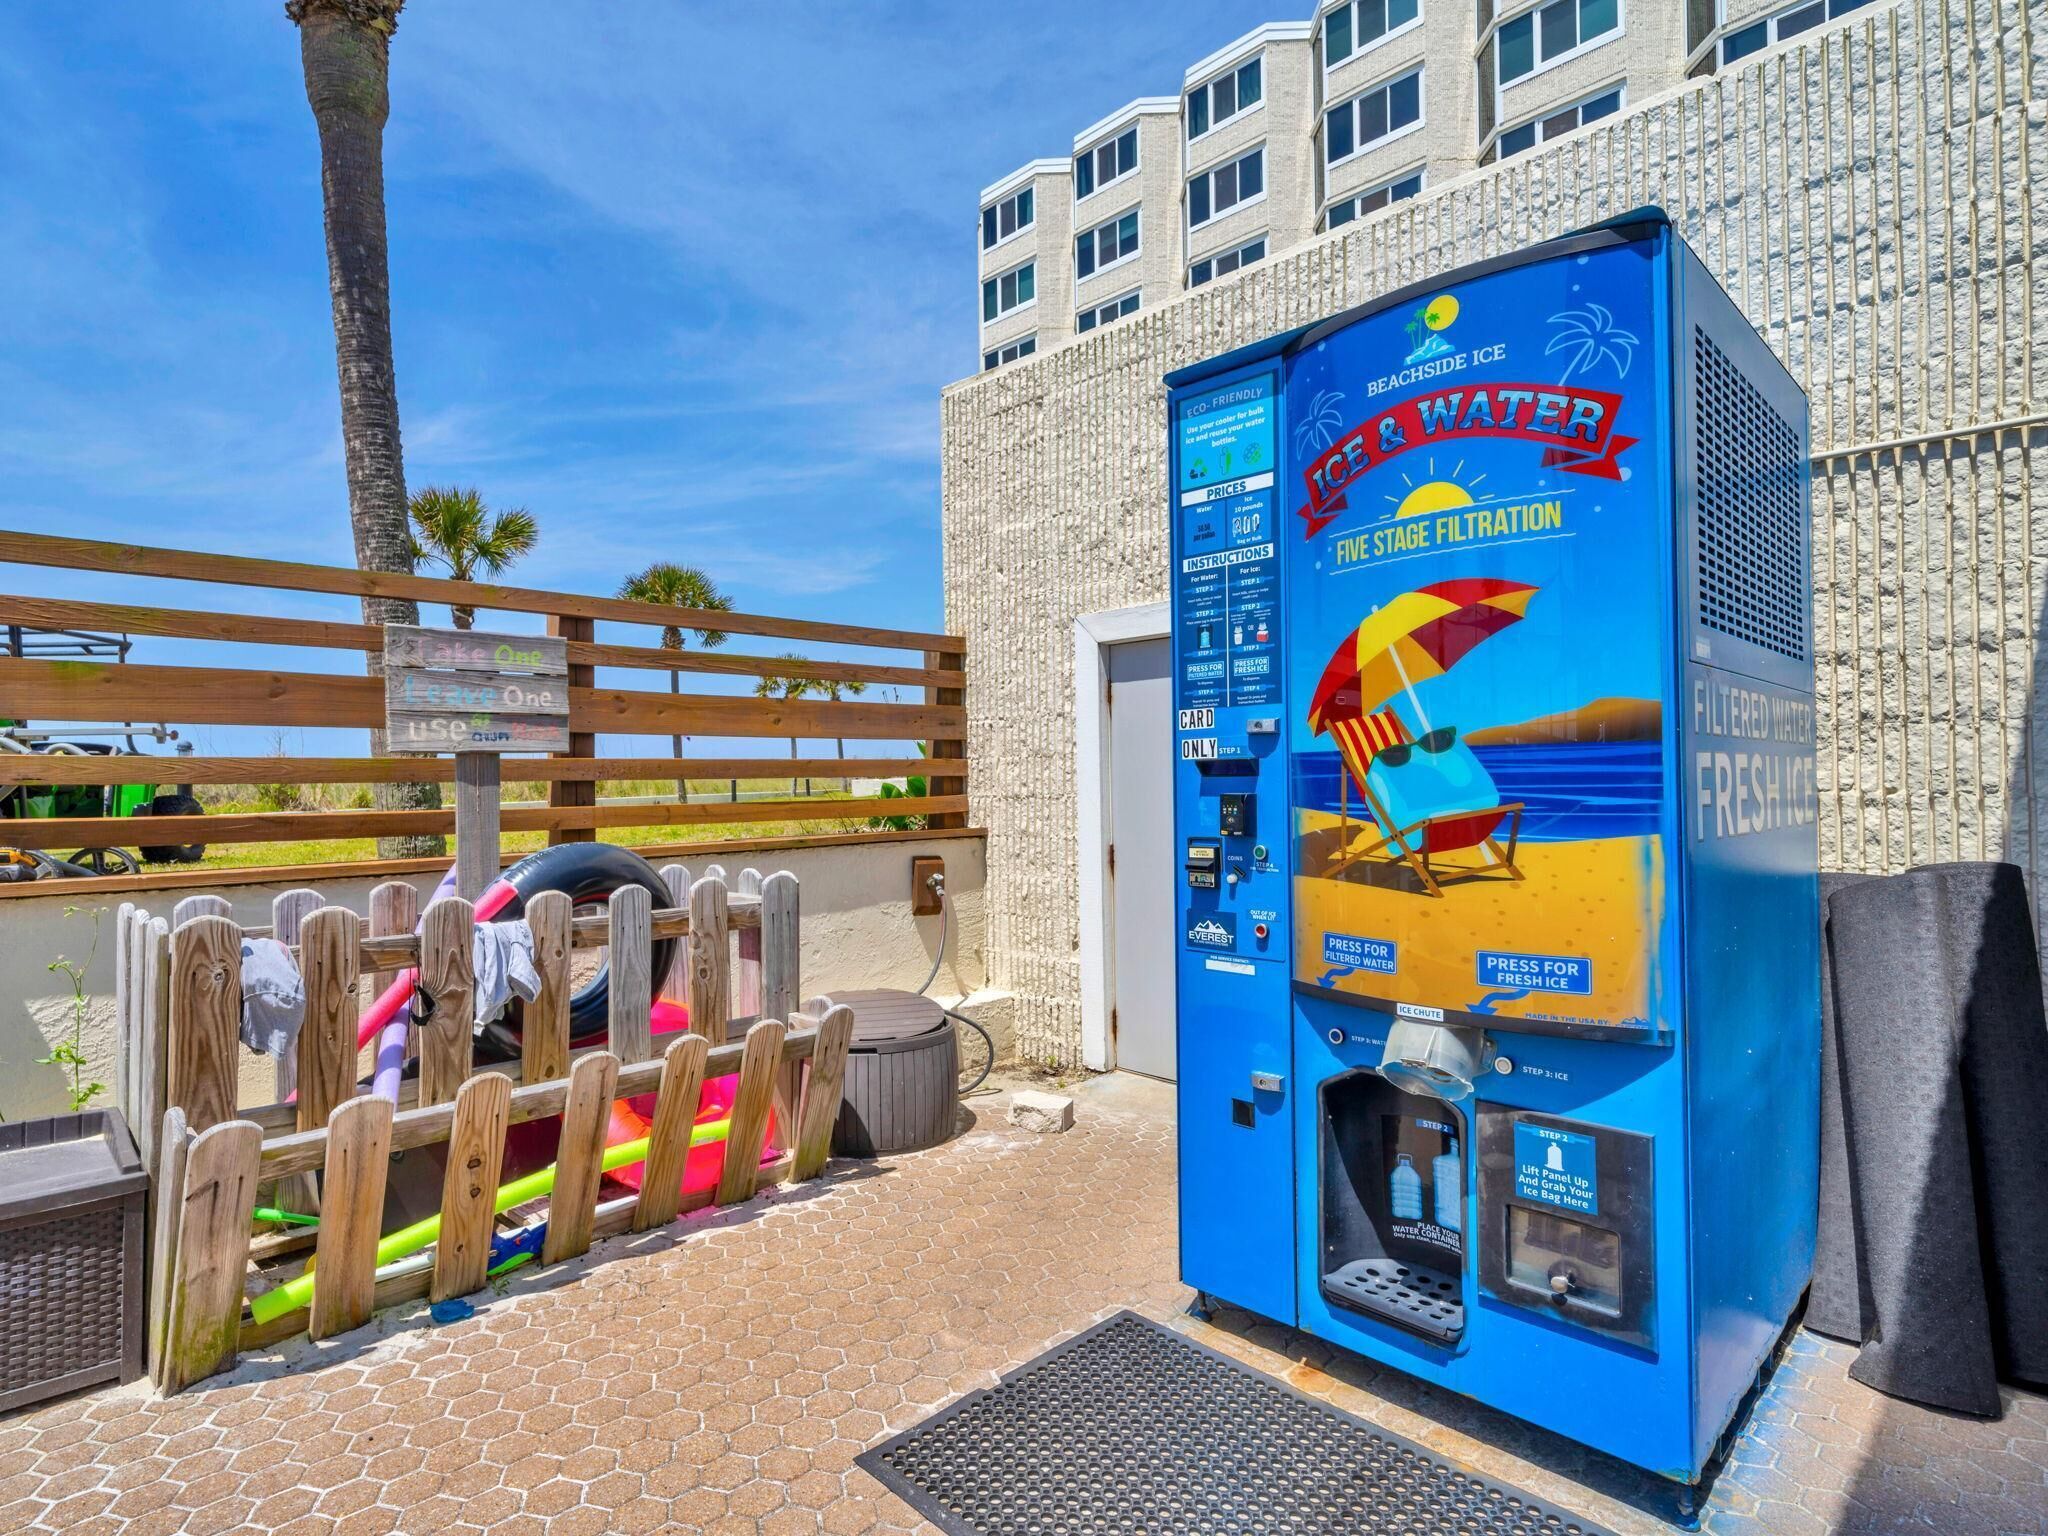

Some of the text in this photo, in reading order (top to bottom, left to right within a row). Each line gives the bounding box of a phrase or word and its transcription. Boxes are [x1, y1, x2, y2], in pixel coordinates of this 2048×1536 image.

[1367, 343, 1506, 397] BEACHSIDE ICE
[1212, 388, 1262, 408] FRIENDLY
[1199, 422, 1214, 432] your
[1216, 414, 1236, 425] cooler
[1237, 411, 1247, 419] for
[1248, 406, 1264, 416] bulk
[1186, 417, 1265, 444] ice and reuse your water
[1212, 436, 1237, 448] bottles.
[1312, 389, 1606, 502] ICE & WATER
[1207, 481, 1246, 500] PRICES
[1197, 505, 1212, 514] Water
[1242, 502, 1263, 512] pounds
[1338, 501, 1562, 565] FIVE STAGE FILTRATION
[1188, 546, 1270, 571] INSTRUCTIONS
[416, 636, 545, 667] Take One
[1188, 665, 1208, 673] PRESS
[1235, 659, 1254, 667] PRESS
[1235, 664, 1268, 674] FRESH ICE
[405, 674, 552, 708] Leave One
[1180, 709, 1214, 729] CARD
[1694, 679, 1812, 744] FILTERED WATER
[1183, 740, 1216, 758] ONLY
[1696, 752, 1814, 842] FRESH ICE
[1189, 930, 1234, 944] EVEREST
[1330, 938, 1388, 957] PRESS FOR
[1326, 950, 1394, 970] FILTERED WATER
[1487, 957, 1579, 976] PRESS FOR
[1498, 973, 1568, 989] FRESH ICE
[1400, 1006, 1441, 1019] ICE CHUTE
[1579, 1017, 1595, 1025] USA
[1372, 1038, 1386, 1046] WAT
[1523, 1066, 1568, 1081] STEP 3: ICE
[1422, 1120, 1448, 1133] STEP 2
[1540, 1130, 1568, 1142] STEP 2
[1523, 1165, 1588, 1188] Lift Panel Up
[1519, 1174, 1594, 1199] And Grab Your
[1524, 1186, 1589, 1209] Ice Bag Here
[1393, 1225, 1460, 1248] WATER CONTAINER
[1417, 1222, 1459, 1240] PLACE YOUR
